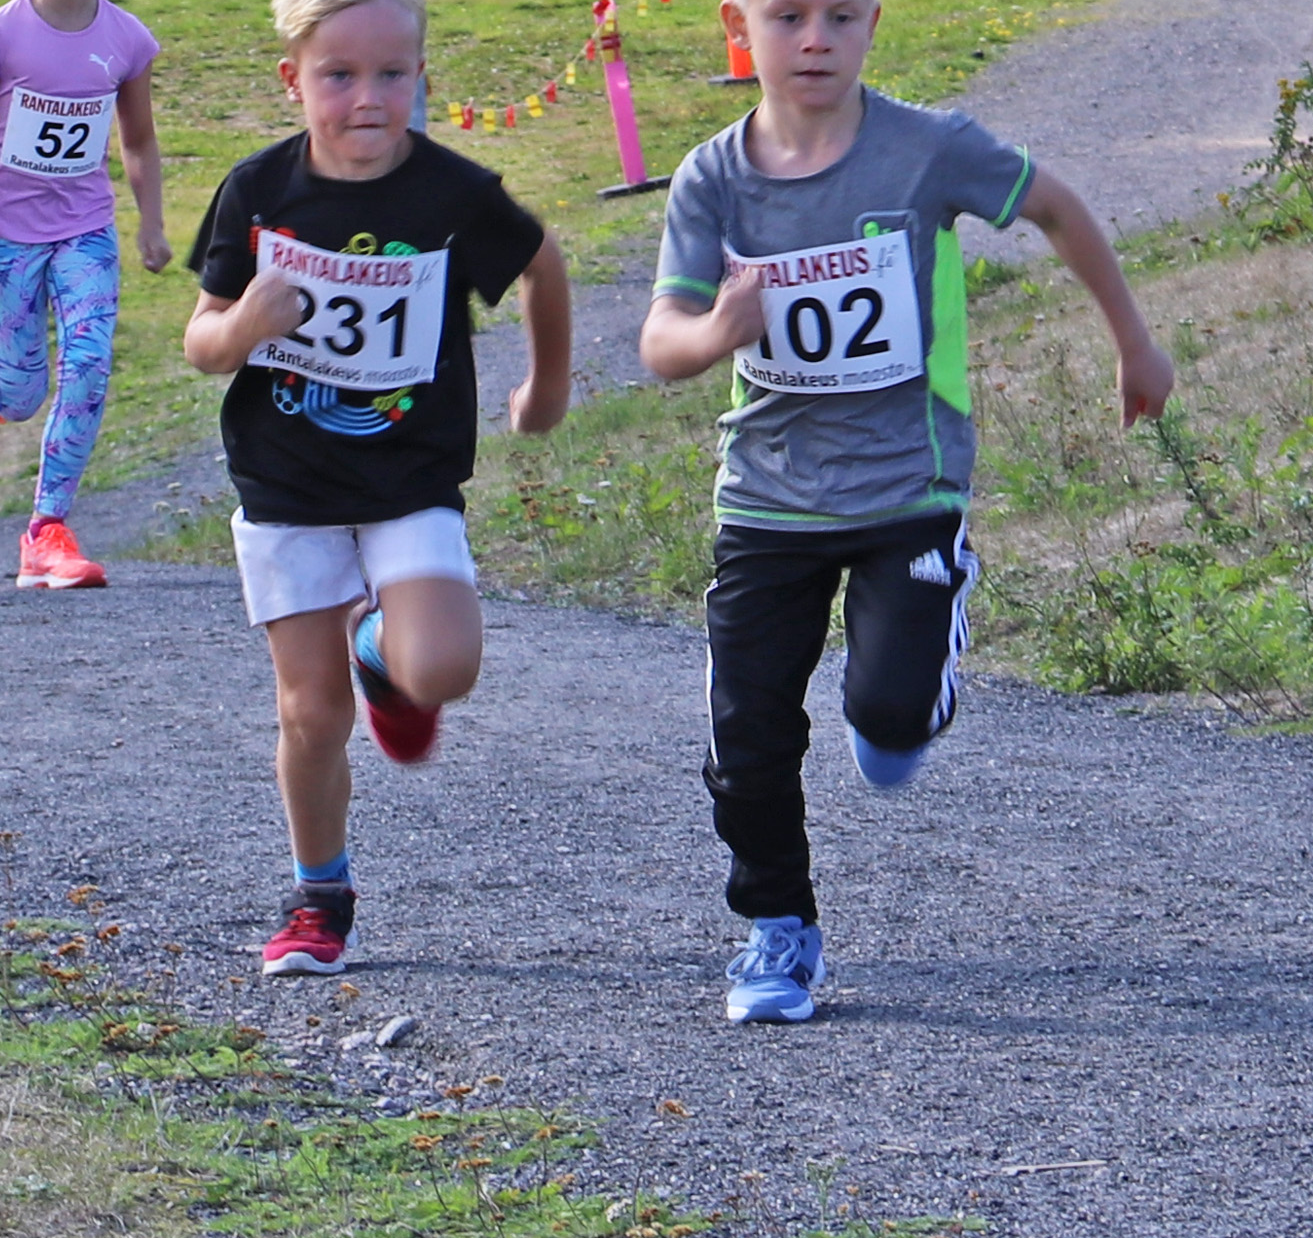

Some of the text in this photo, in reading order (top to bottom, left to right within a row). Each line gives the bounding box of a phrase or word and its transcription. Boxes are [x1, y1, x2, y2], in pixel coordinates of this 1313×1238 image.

[21, 93, 103, 117] RANTALAKEUS
[34, 121, 90, 159] 52
[10, 154, 70, 174] Rantalakeus
[271, 241, 414, 287] RANTALAKEUS
[283, 284, 411, 358] 231
[743, 357, 840, 388] Rantalakeus
